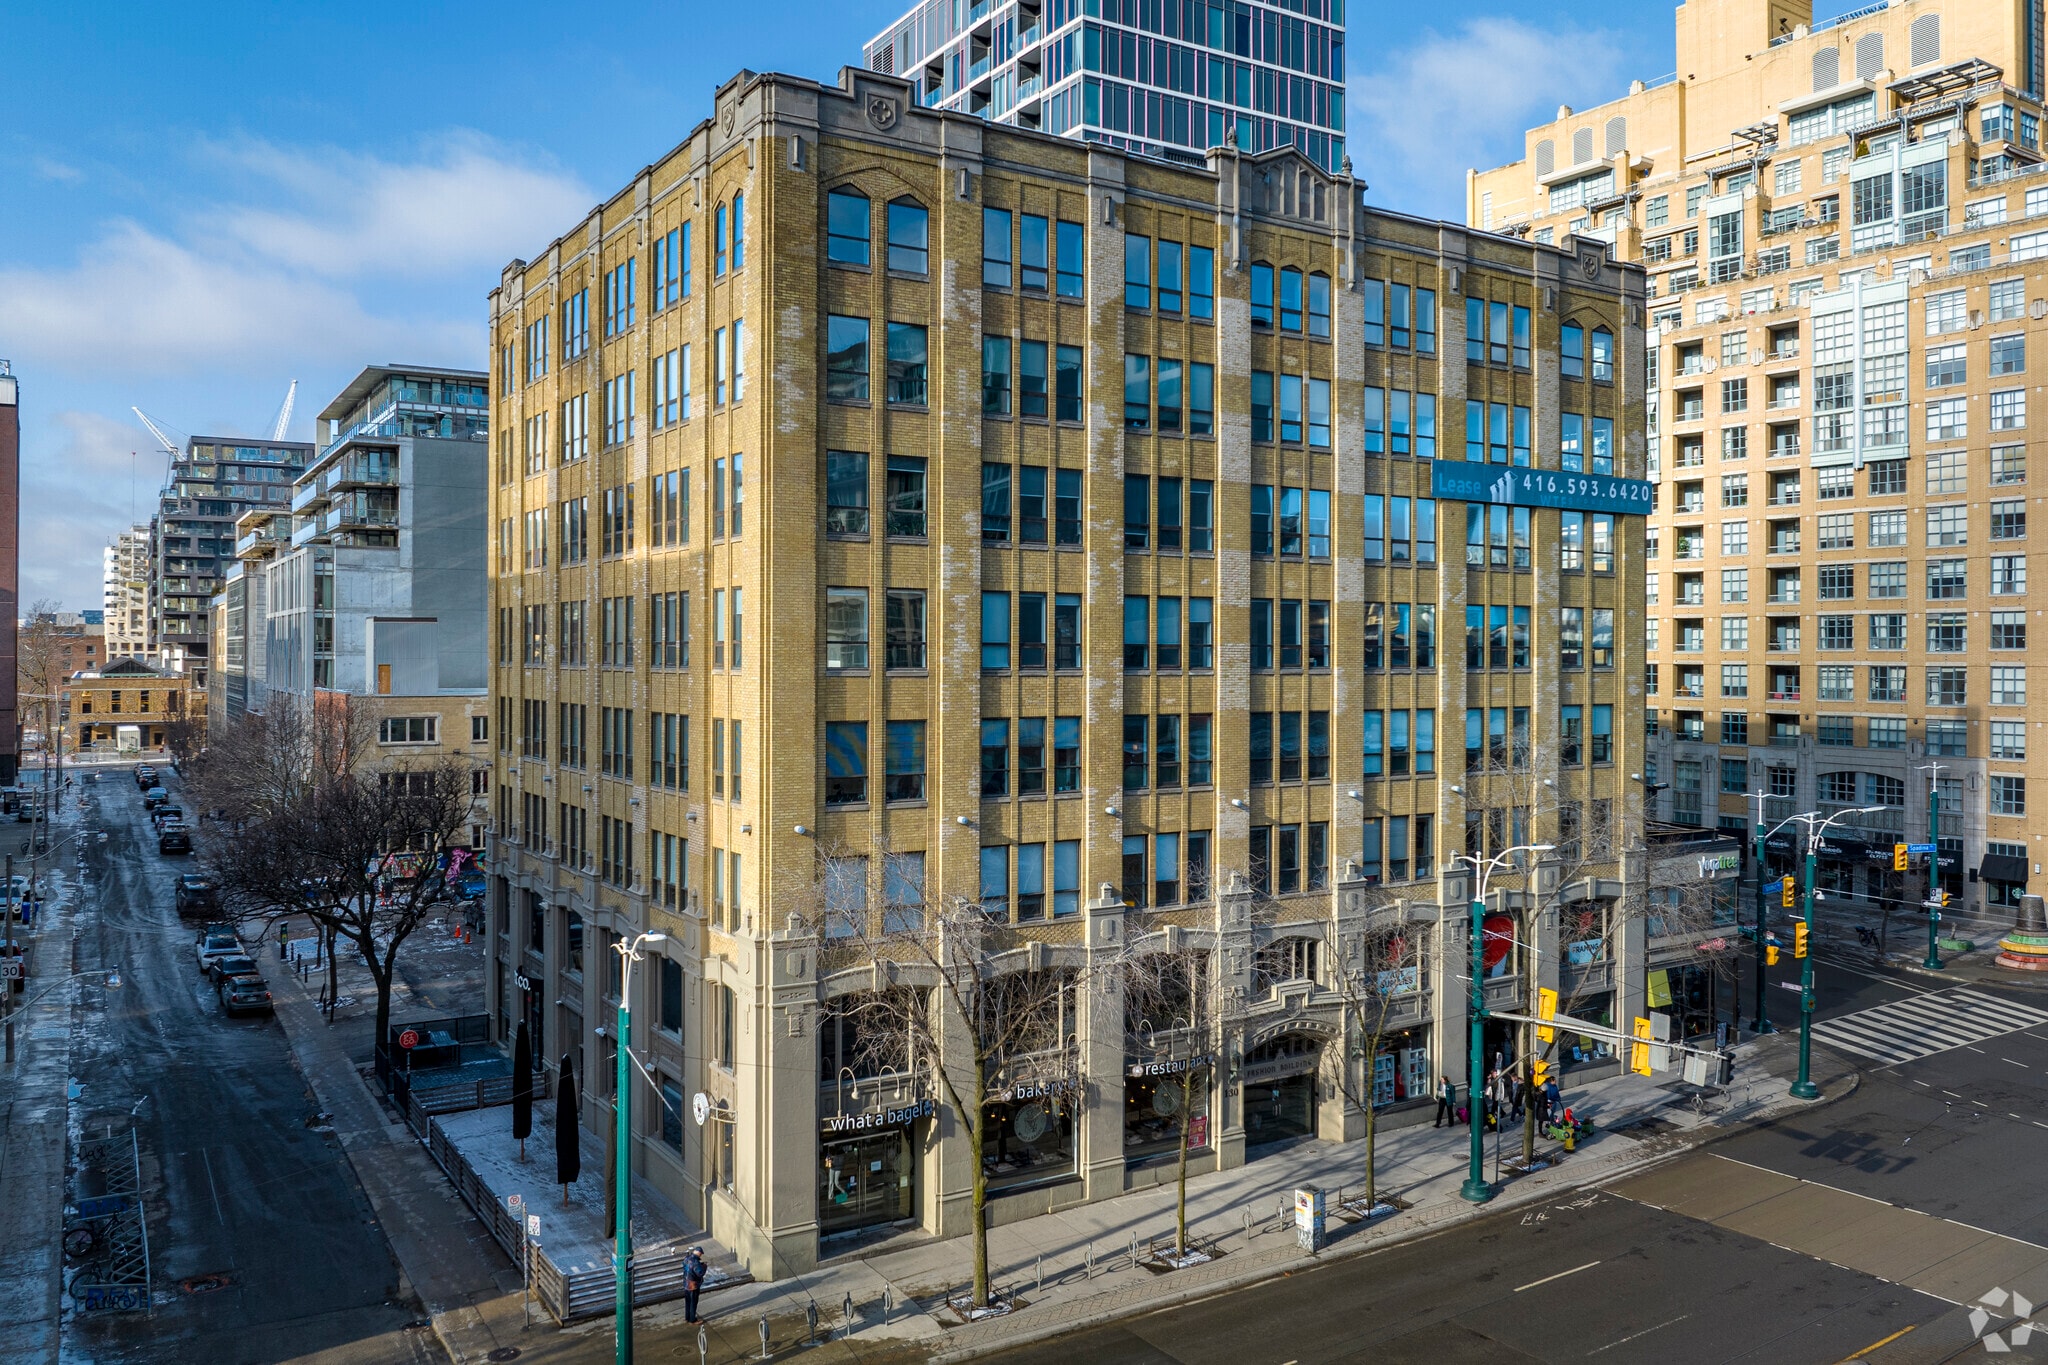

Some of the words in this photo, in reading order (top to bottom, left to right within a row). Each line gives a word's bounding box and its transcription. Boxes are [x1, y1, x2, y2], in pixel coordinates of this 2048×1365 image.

[1439, 472, 1481, 495] Lease
[1523, 473, 1649, 501] 416.593.6420
[2, 966, 17, 976] 30
[1145, 1055, 1206, 1076] restauant
[1017, 1080, 1065, 1099] bakery
[1224, 1088, 1239, 1098] 130
[831, 1112, 872, 1131] what
[875, 1113, 883, 1126] a
[887, 1100, 923, 1125] bagel
